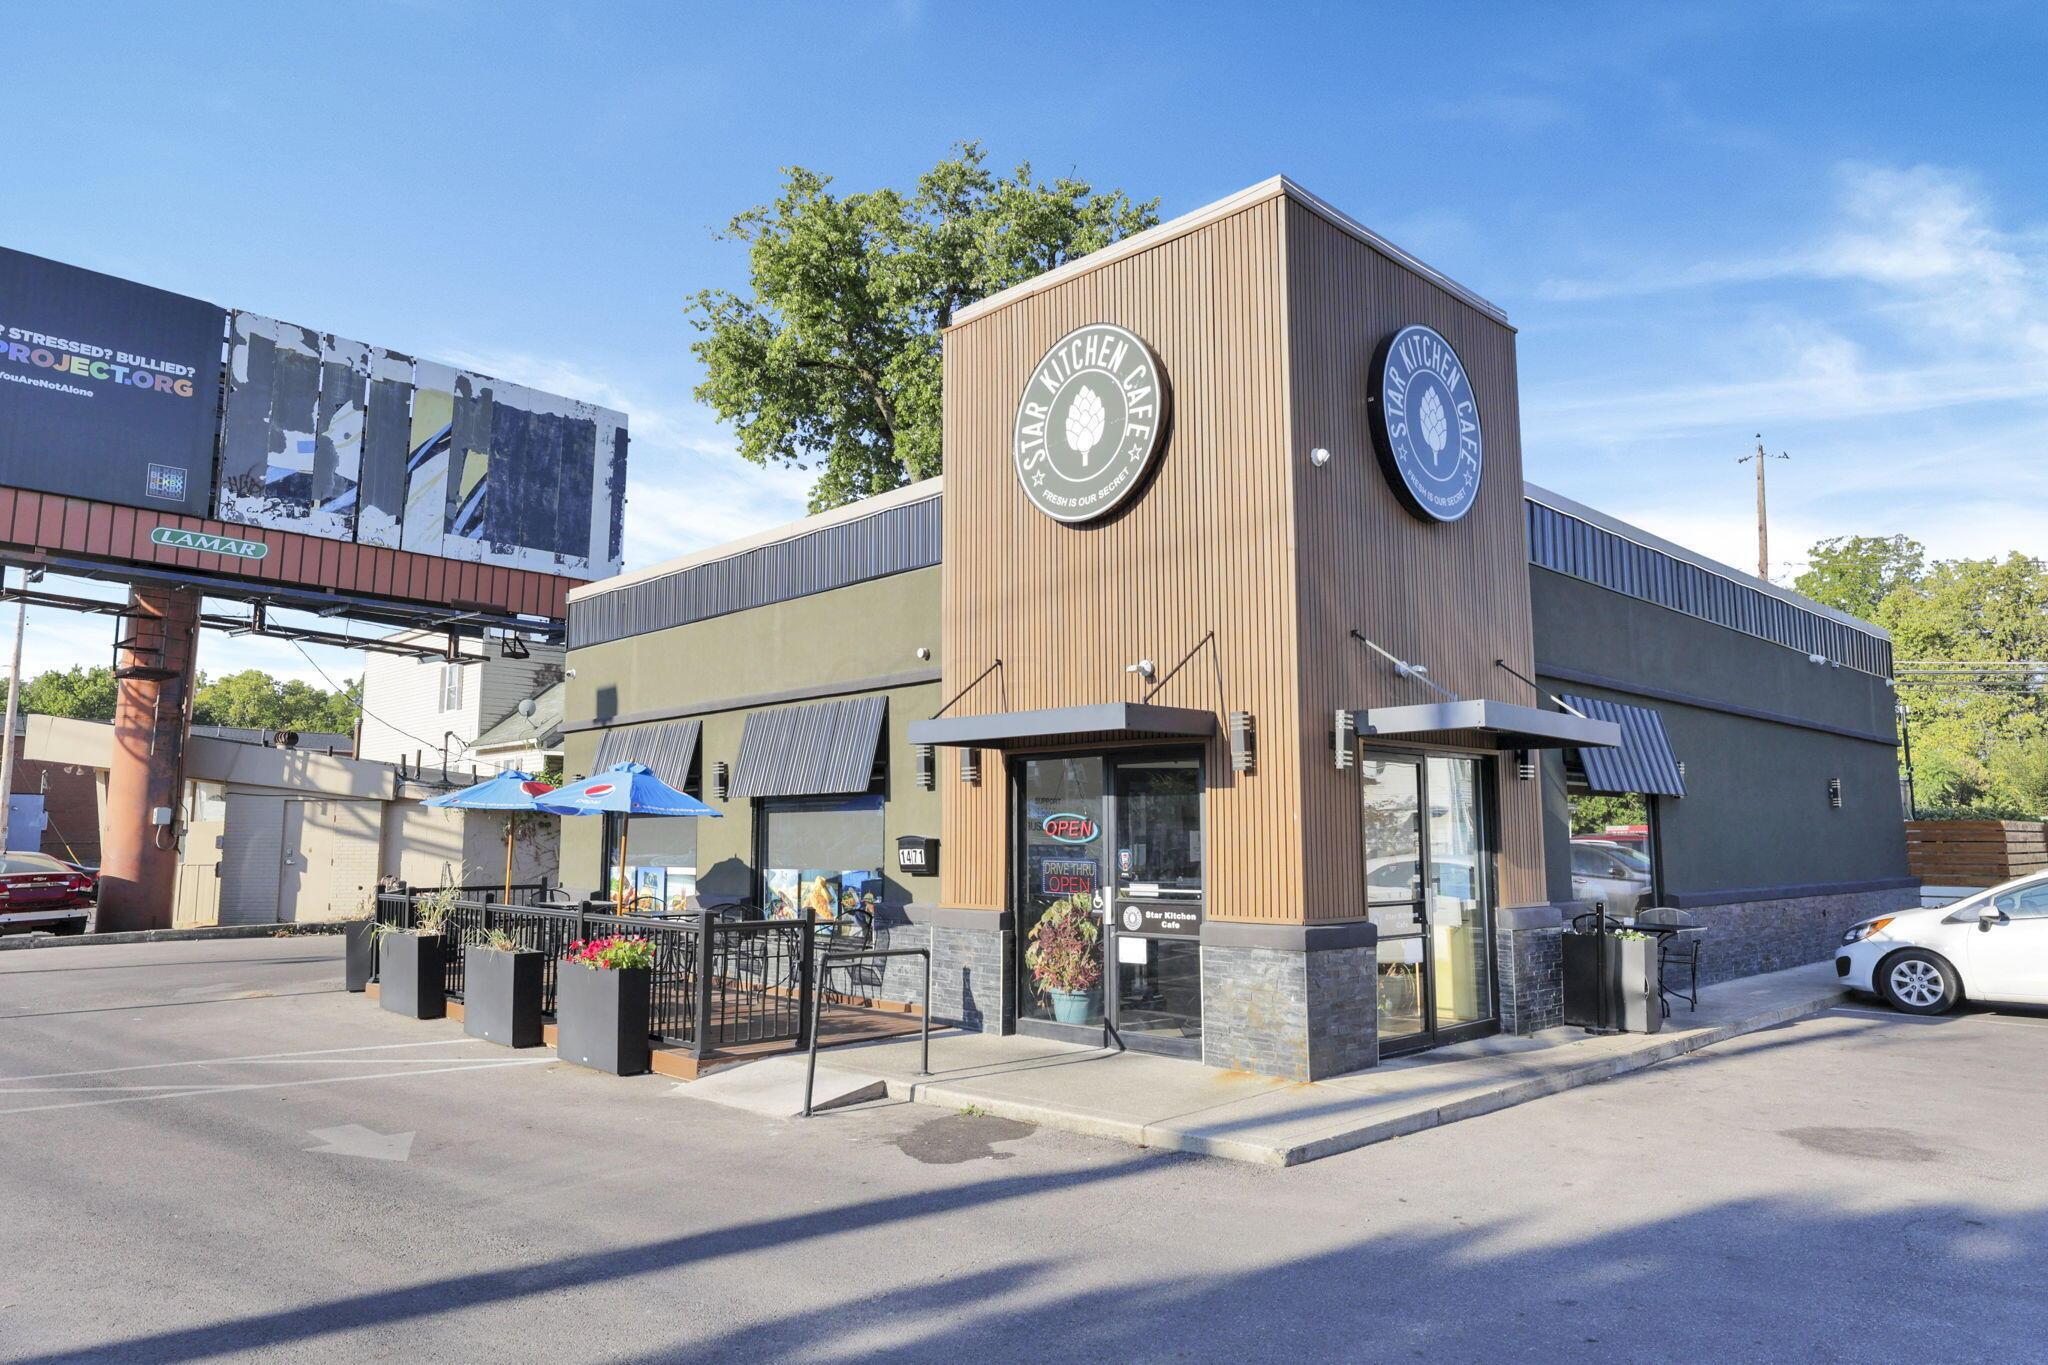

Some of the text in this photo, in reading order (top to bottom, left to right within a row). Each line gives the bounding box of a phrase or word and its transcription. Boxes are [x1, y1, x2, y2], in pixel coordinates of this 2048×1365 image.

[8, 327, 196, 378] STRESSED? BULLIED?
[1020, 334, 1153, 471] STAR KITCHEN CAFE
[1387, 335, 1478, 473] STAR KITCHEN CAFE
[1042, 466, 1130, 507] FRESH IS OUR SECRET
[1407, 469, 1427, 497] FRESH
[1427, 491, 1434, 502] IS
[1434, 496, 1447, 507] OUR
[160, 530, 256, 556] LAMAR
[1045, 820, 1092, 837] OPEN
[901, 850, 924, 864] 1471
[1044, 862, 1095, 876] DRIVE THRU
[1049, 876, 1090, 893] OPEN
[1145, 911, 1197, 920] Star Kitchen
[1161, 921, 1180, 929] Cafe
